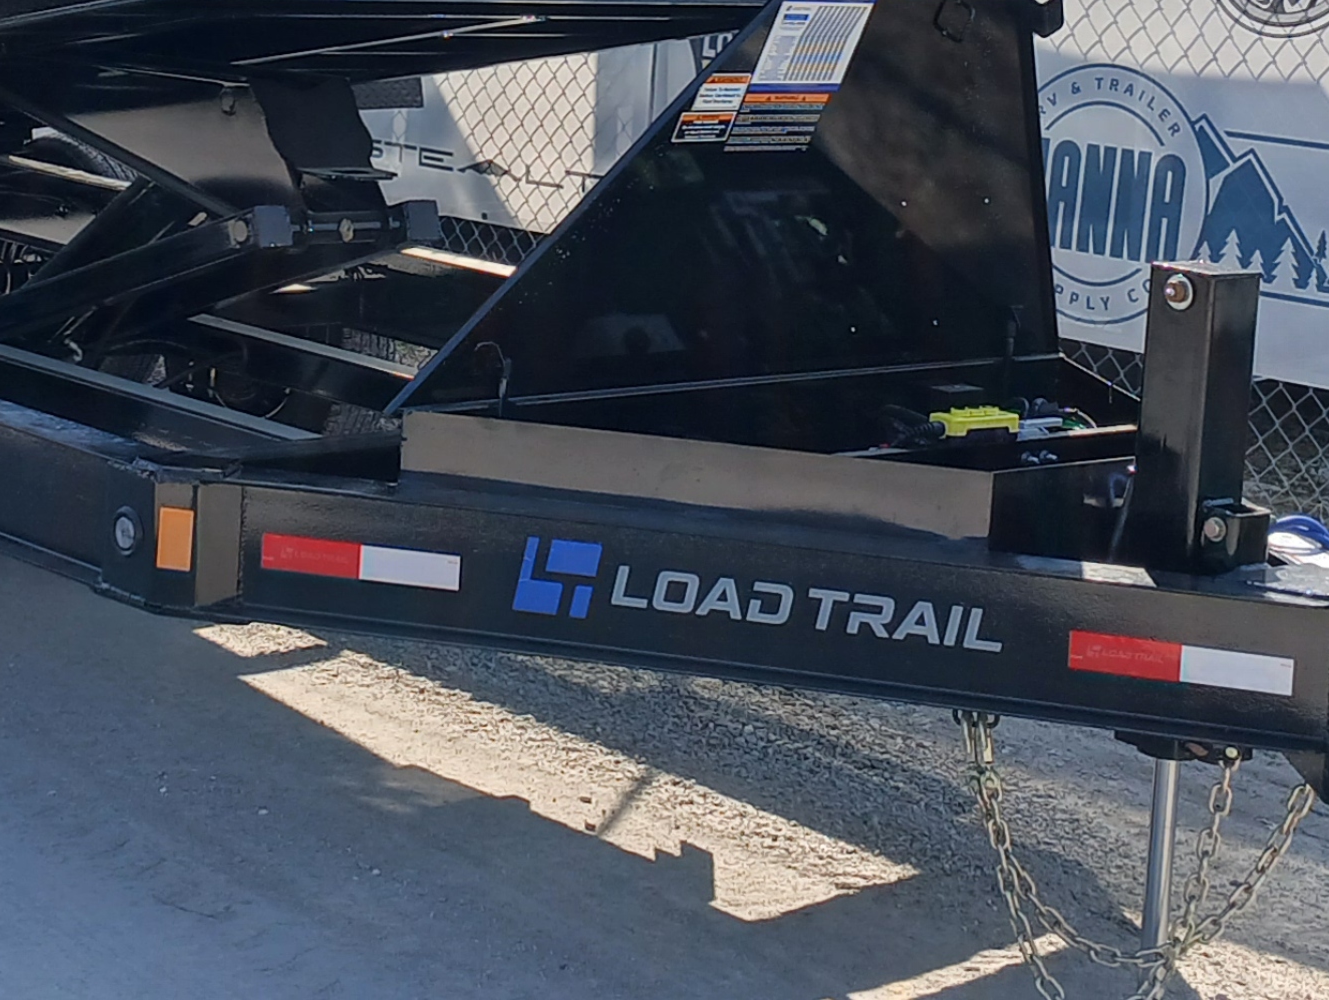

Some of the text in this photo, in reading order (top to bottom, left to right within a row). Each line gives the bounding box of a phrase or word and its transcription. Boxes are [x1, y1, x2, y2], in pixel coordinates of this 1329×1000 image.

[1094, 77, 1181, 137] TRAILER
[1042, 137, 1186, 263] ANNA
[610, 564, 1004, 653] LOAD TRAIL
